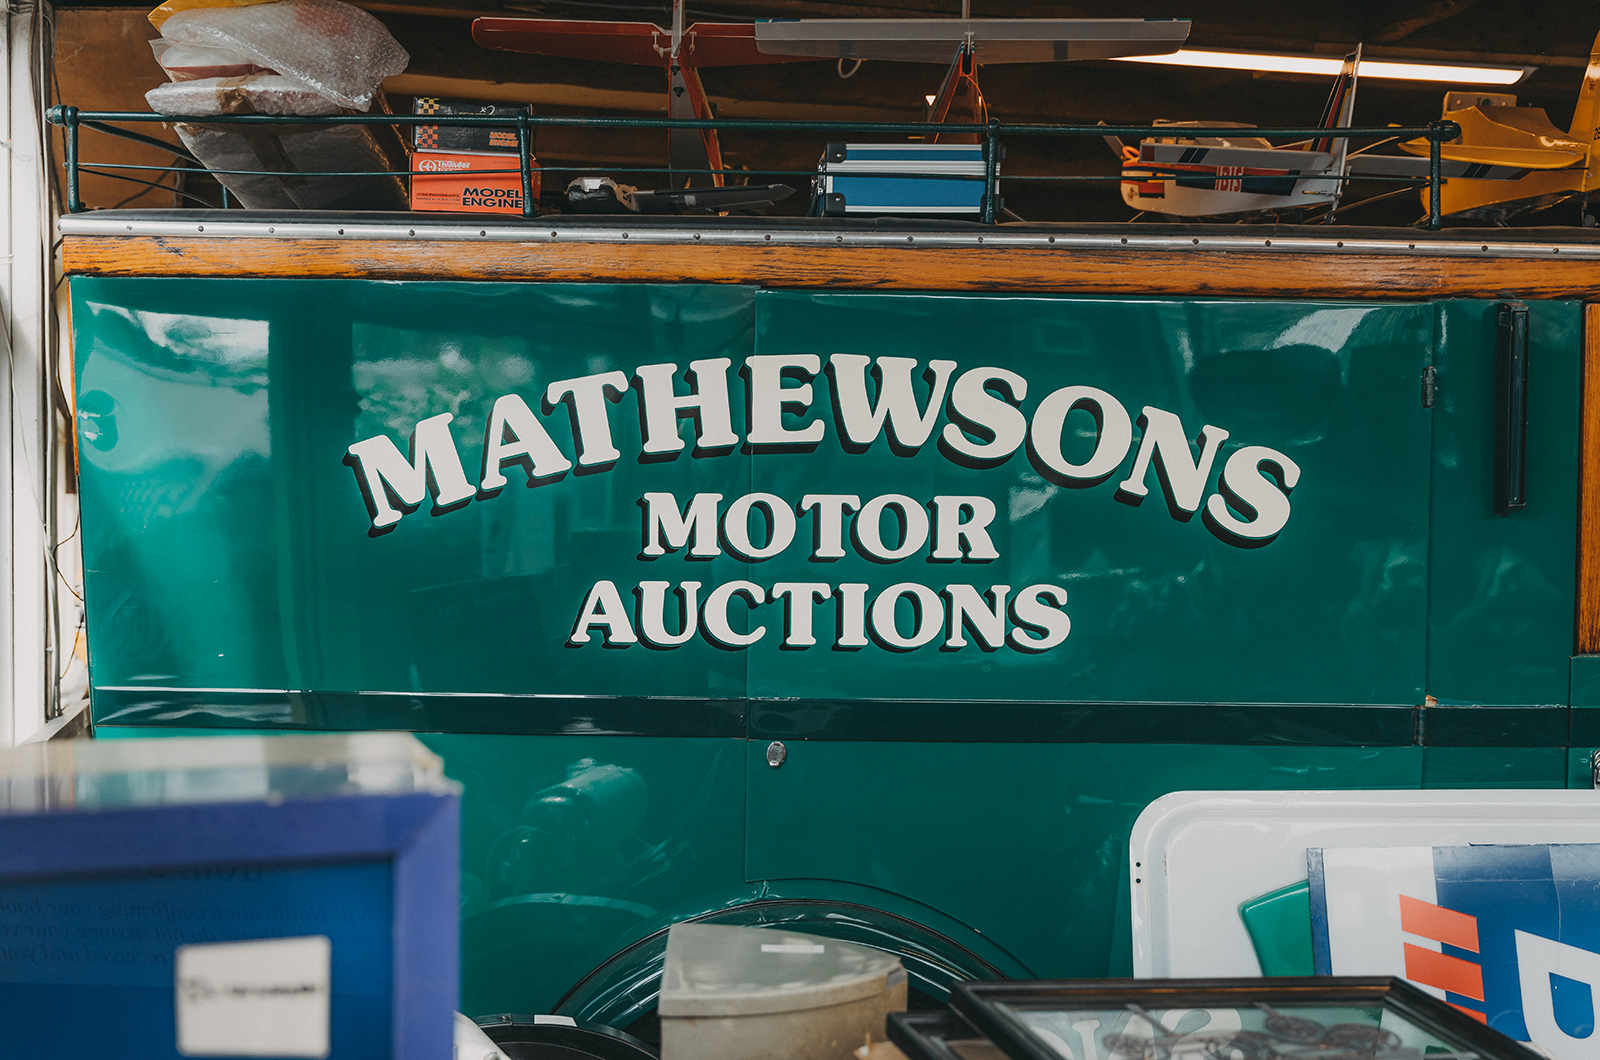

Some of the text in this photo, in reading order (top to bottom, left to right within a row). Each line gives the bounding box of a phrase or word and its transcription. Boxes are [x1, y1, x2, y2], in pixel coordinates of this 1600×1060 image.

[489, 131, 517, 140] MODEL
[489, 139, 519, 147] ENGINE
[435, 160, 471, 169] Thunder
[462, 187, 523, 199] MODEL
[462, 197, 523, 209] ENGINE
[347, 353, 1302, 542] MATHEWSONS
[641, 491, 1000, 560] MOTOR
[568, 580, 1072, 650] AUCTIONS
